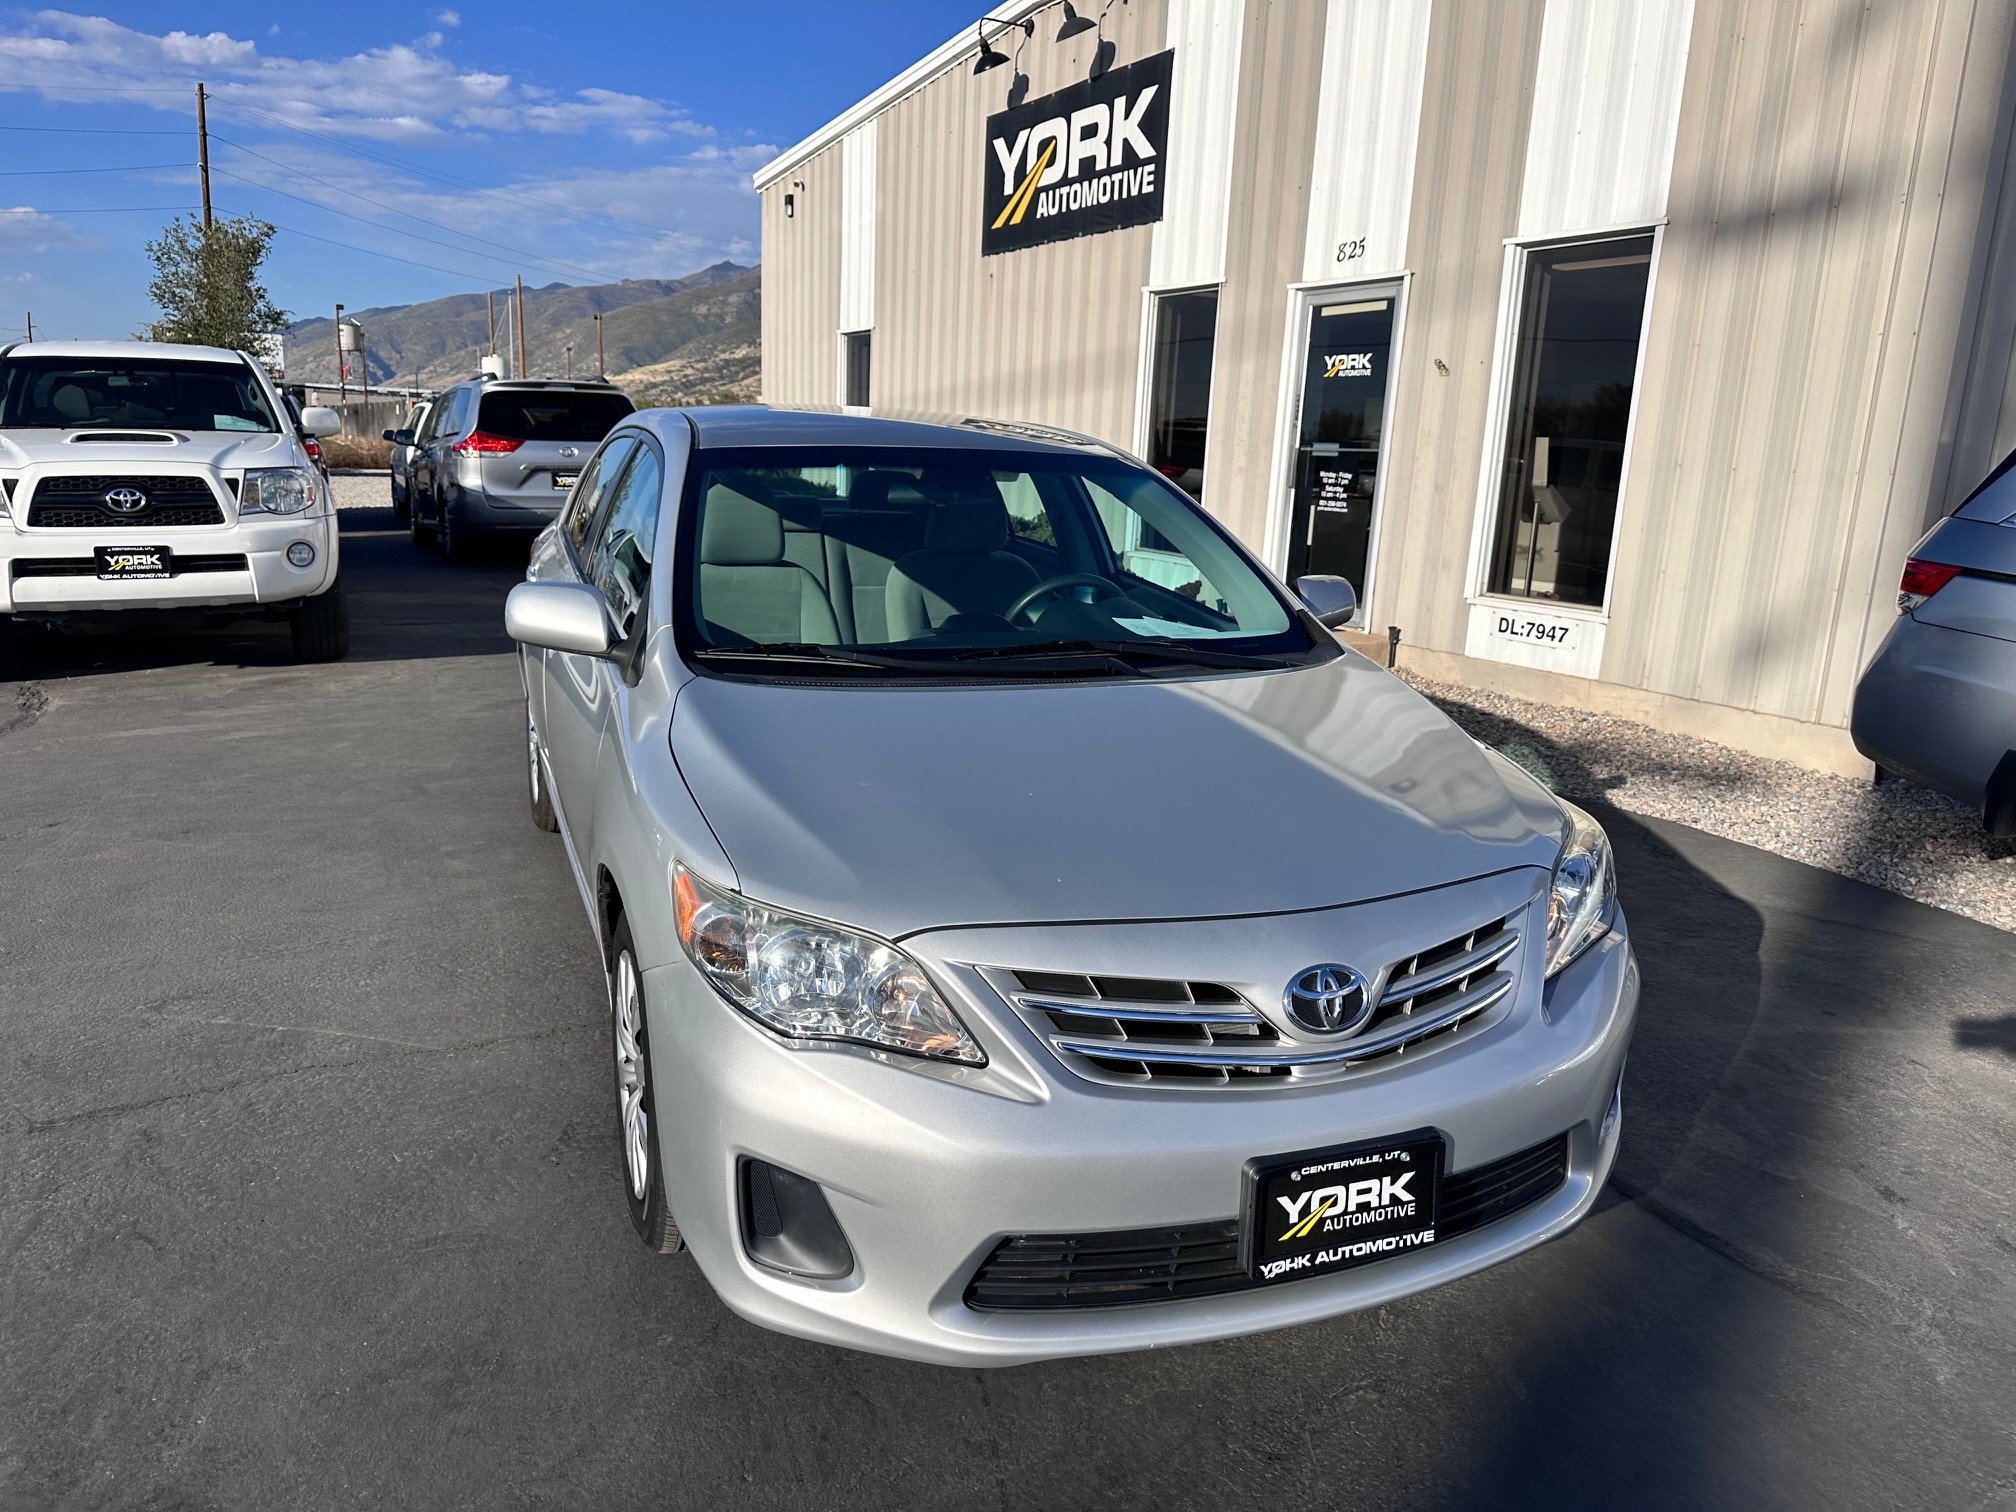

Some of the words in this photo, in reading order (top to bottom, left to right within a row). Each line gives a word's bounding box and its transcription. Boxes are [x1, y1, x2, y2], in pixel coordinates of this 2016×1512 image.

[992, 84, 1159, 196] YORK
[1036, 164, 1156, 219] AUTOMOTIVE
[1336, 236, 1366, 262] 825
[1323, 353, 1373, 370] YORK
[1337, 369, 1372, 377] AUTOMOTIVE
[555, 476, 578, 485] YOR
[104, 554, 162, 566] YORK
[1498, 617, 1569, 643] DL:7947
[1301, 1153, 1382, 1176] CENTERVILLE,
[1385, 1150, 1401, 1160] UT
[1276, 1171, 1416, 1224] YORK
[1323, 1203, 1416, 1232] AUTOMOTIVE
